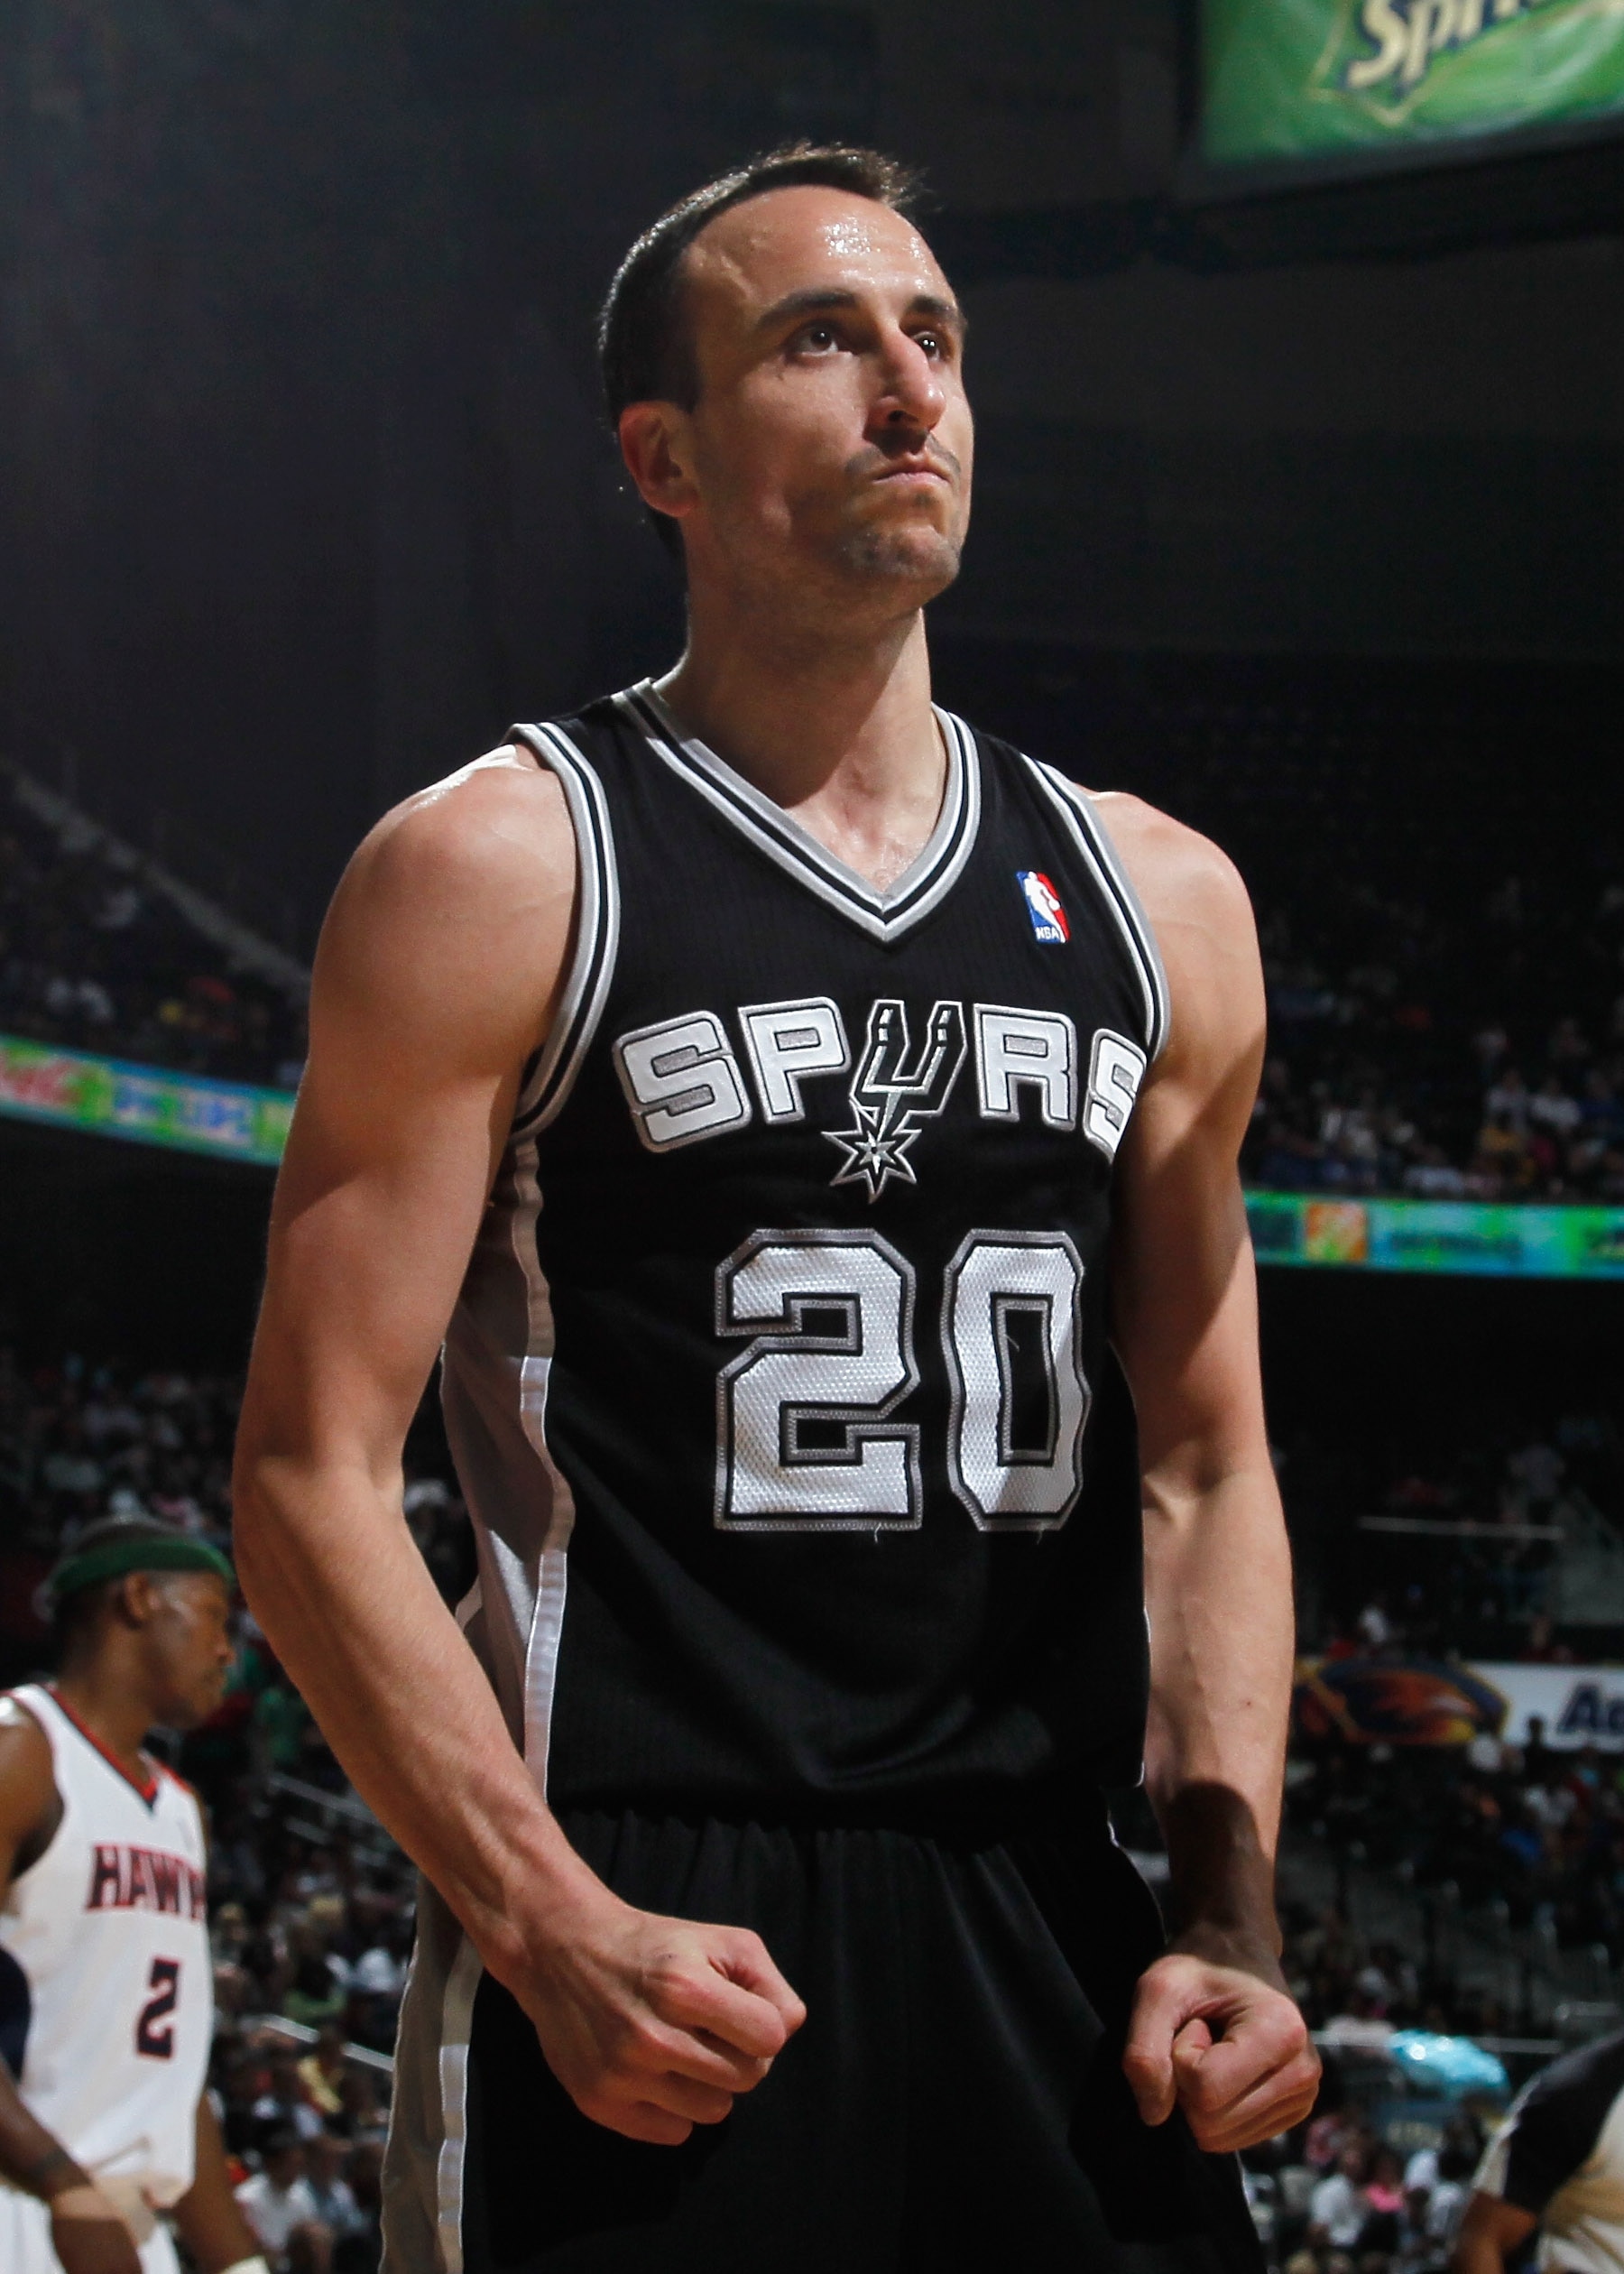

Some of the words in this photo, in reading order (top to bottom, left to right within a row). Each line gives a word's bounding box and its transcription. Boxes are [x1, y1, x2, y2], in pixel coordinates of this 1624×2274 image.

[1344, 0, 1525, 88] Spr
[1034, 926, 1060, 941] NBA
[612, 996, 1148, 1205] SPURS
[714, 1228, 1093, 1532] 20
[135, 1955, 181, 2060] 2
